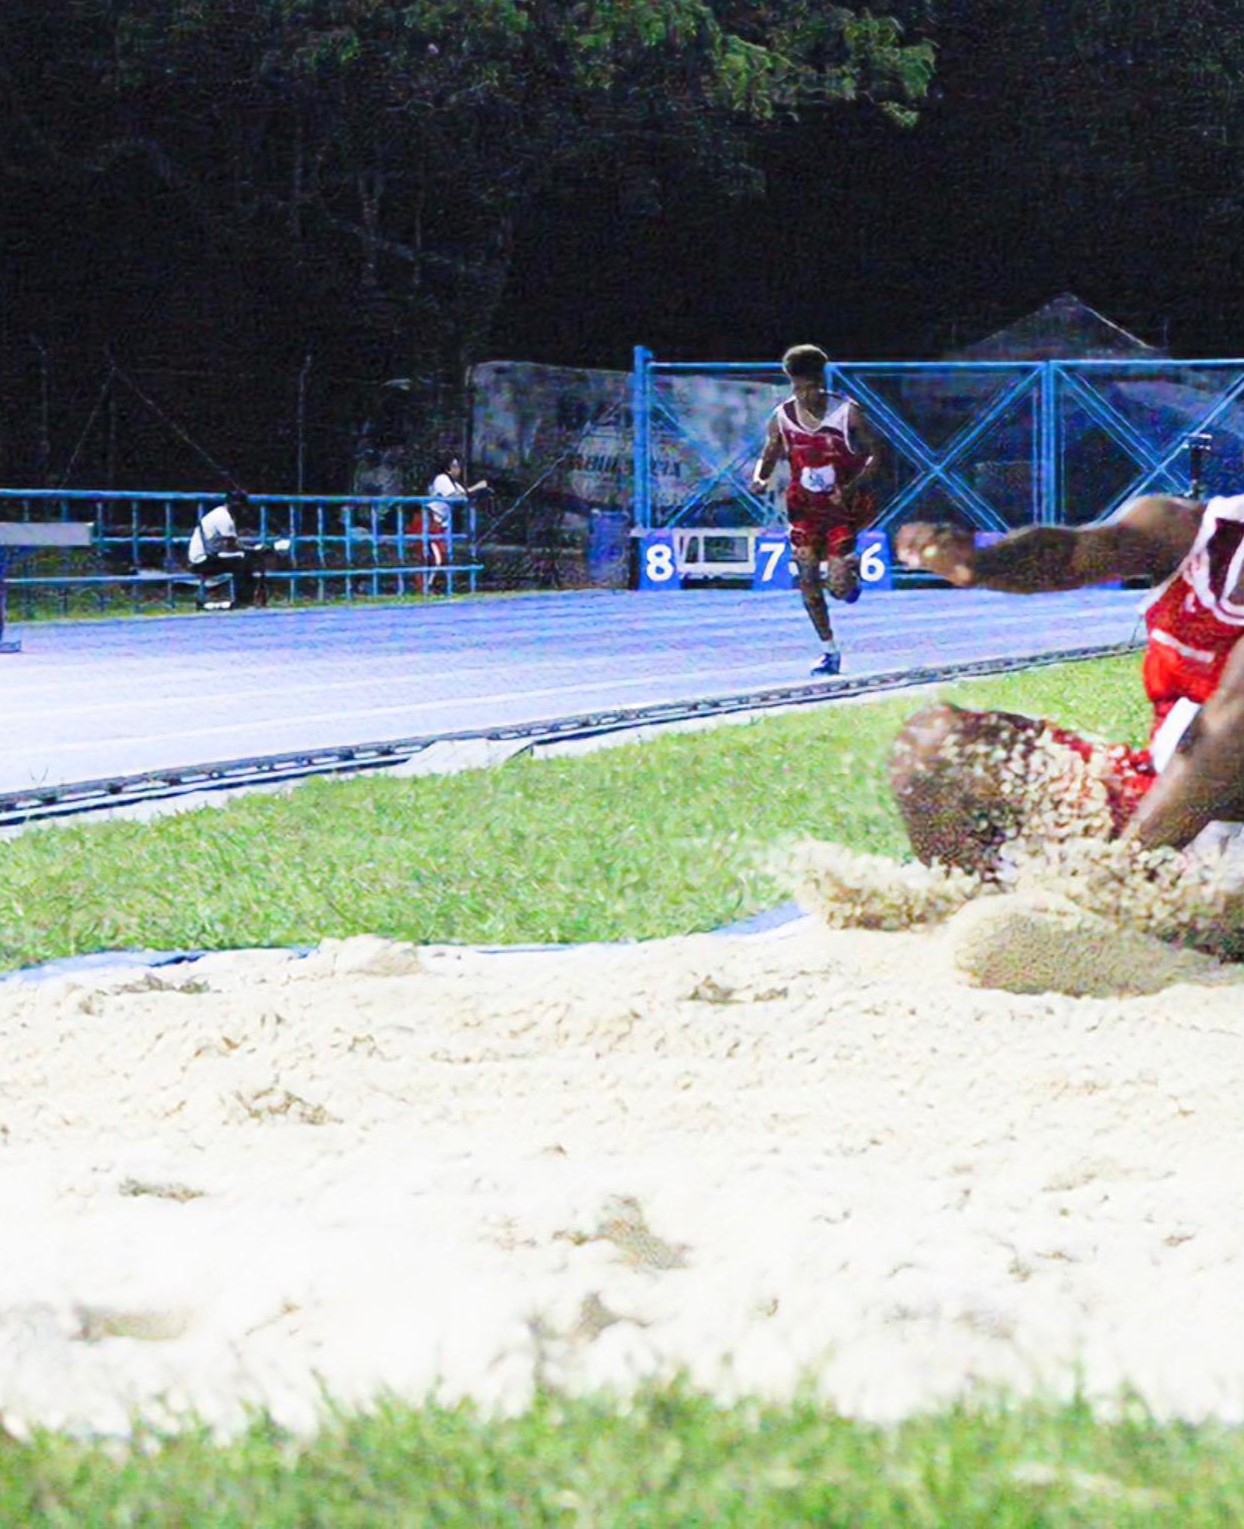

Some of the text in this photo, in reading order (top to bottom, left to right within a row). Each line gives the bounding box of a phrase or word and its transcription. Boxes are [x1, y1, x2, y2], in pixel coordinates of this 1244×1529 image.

[646, 544, 674, 582] 8
[759, 543, 785, 582] 7
[860, 542, 885, 582] 6
